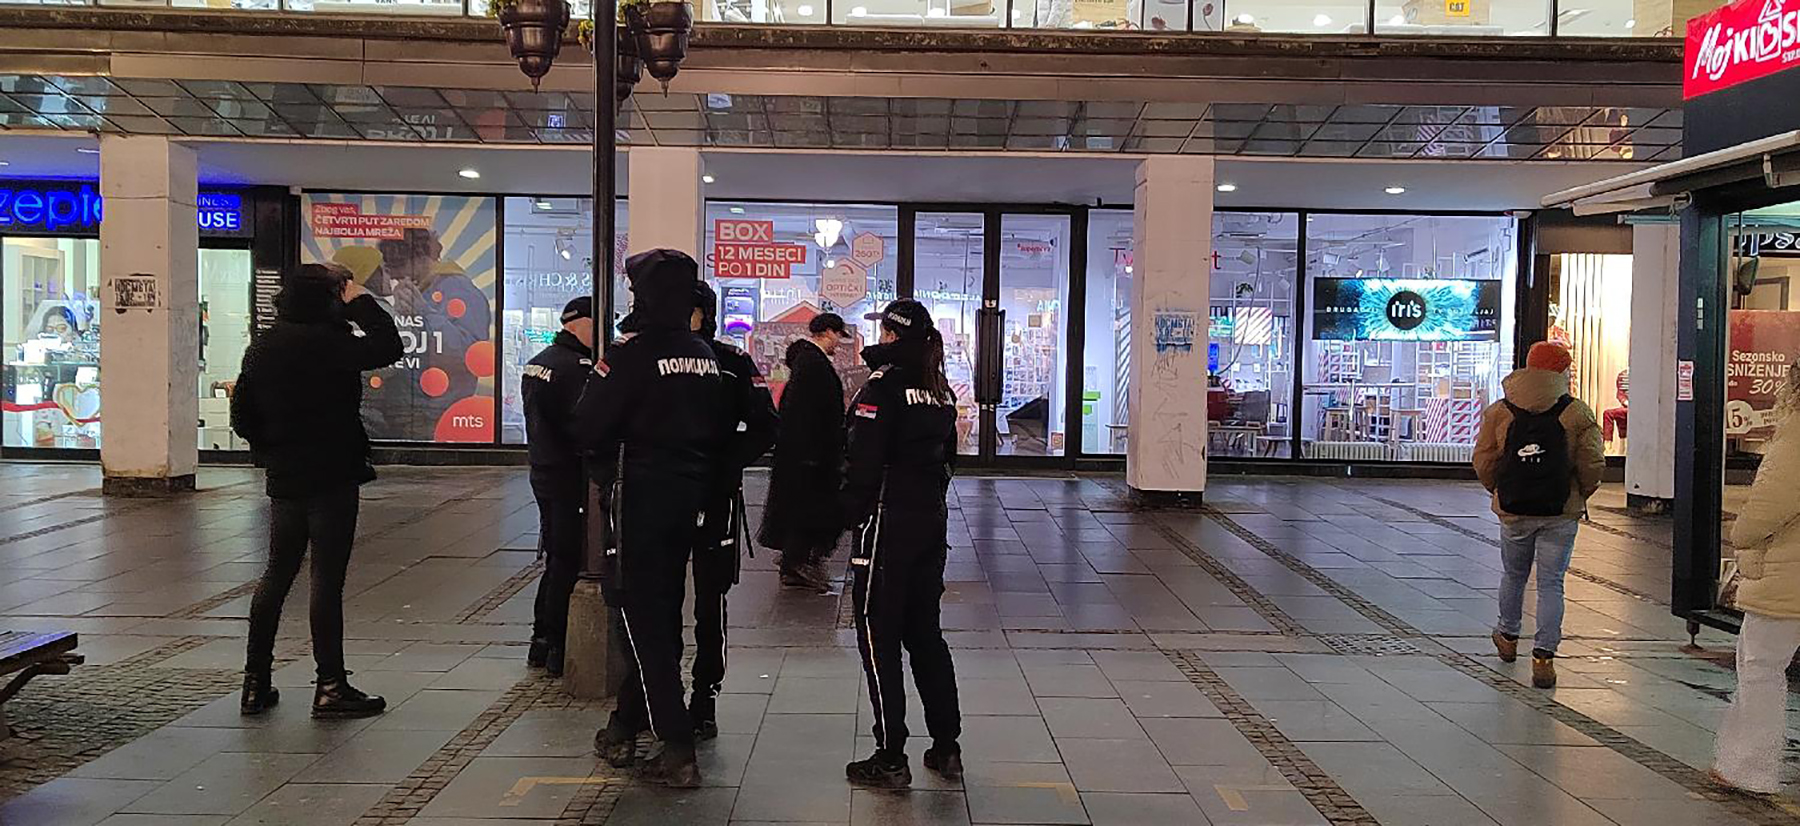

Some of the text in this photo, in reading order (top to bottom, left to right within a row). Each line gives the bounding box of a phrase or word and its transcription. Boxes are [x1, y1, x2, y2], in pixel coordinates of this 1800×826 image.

[359, 217, 380, 225] PUT
[380, 217, 429, 226] ZAREDOM
[366, 227, 401, 237] MREŽA
[719, 222, 769, 241] BOX
[718, 246, 802, 261] 12 MESECI
[719, 262, 785, 276] PO 1 DIN
[394, 315, 424, 327] NAS
[433, 331, 442, 354] 1
[1732, 350, 1785, 362] Sezonsko
[405, 358, 420, 369] VI
[1749, 379, 1788, 396] 30%
[452, 415, 484, 428] mts
